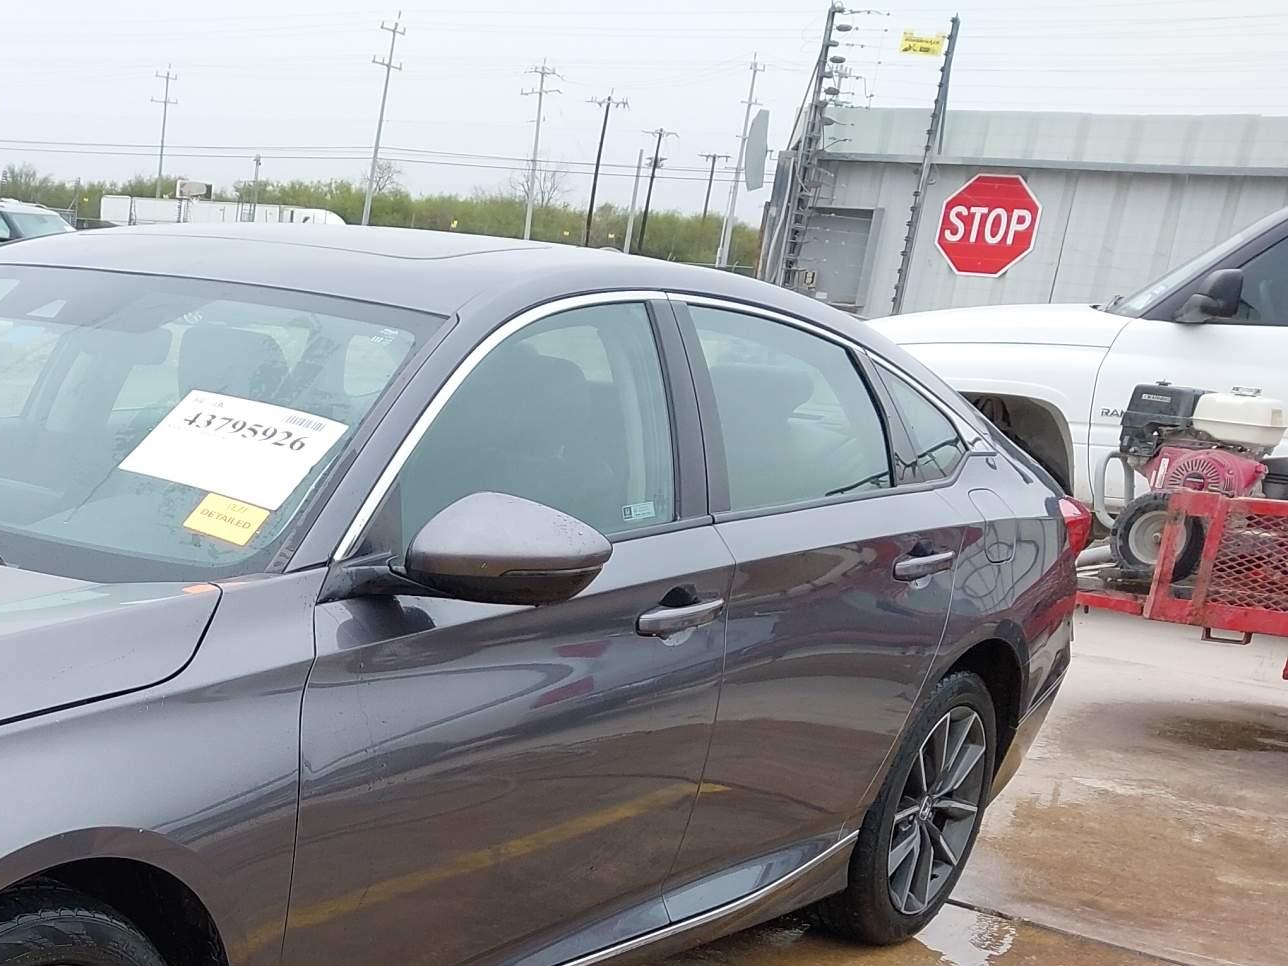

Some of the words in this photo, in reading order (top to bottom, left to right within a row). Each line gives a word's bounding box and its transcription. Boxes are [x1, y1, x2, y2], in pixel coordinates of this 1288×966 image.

[944, 205, 1033, 246] STOP
[185, 412, 306, 451] 43795926
[200, 509, 251, 529] DETAILED
